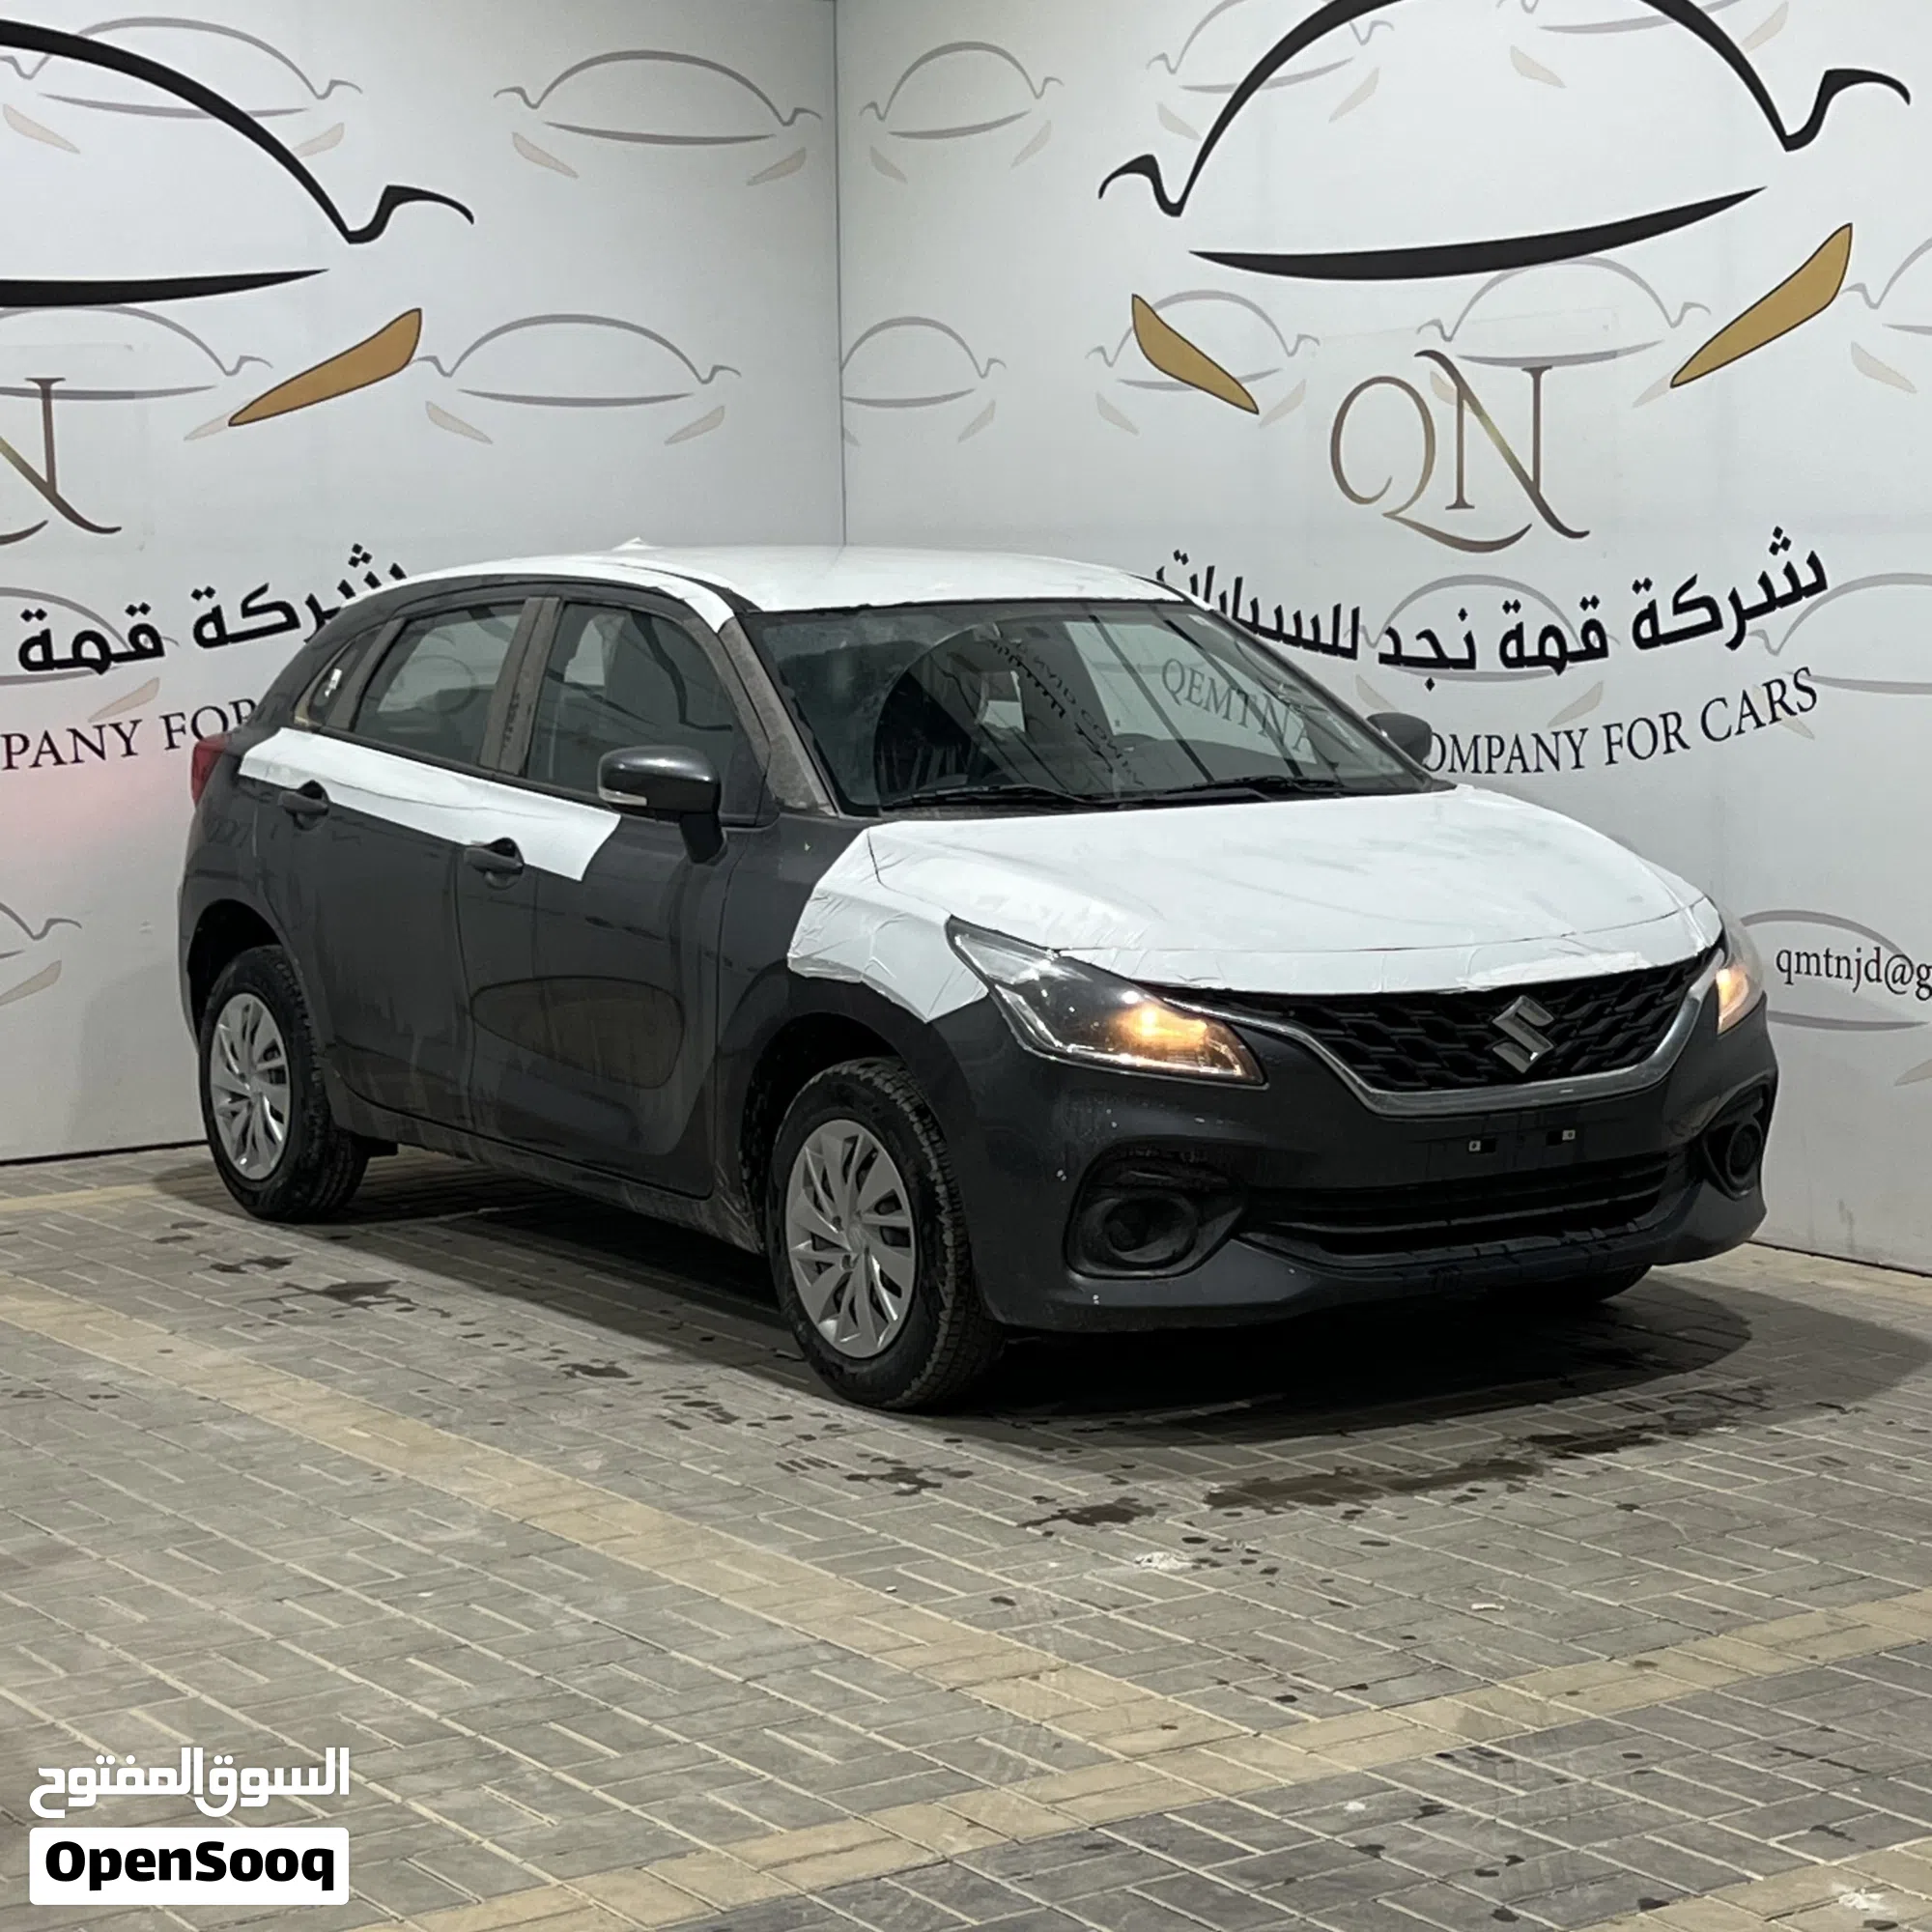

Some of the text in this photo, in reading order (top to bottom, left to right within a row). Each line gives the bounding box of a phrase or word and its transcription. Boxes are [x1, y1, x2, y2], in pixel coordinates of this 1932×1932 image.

[1632, 526, 1828, 651] شركة
[18, 602, 165, 675] قمة
[1379, 608, 1476, 692] نجد
[1499, 594, 1608, 676] قمة
[1423, 727, 1589, 774] OMPANY
[1603, 711, 1690, 766] FOR
[1700, 667, 1818, 742] CARS
[1776, 947, 1932, 1001] qmtnjd@g
